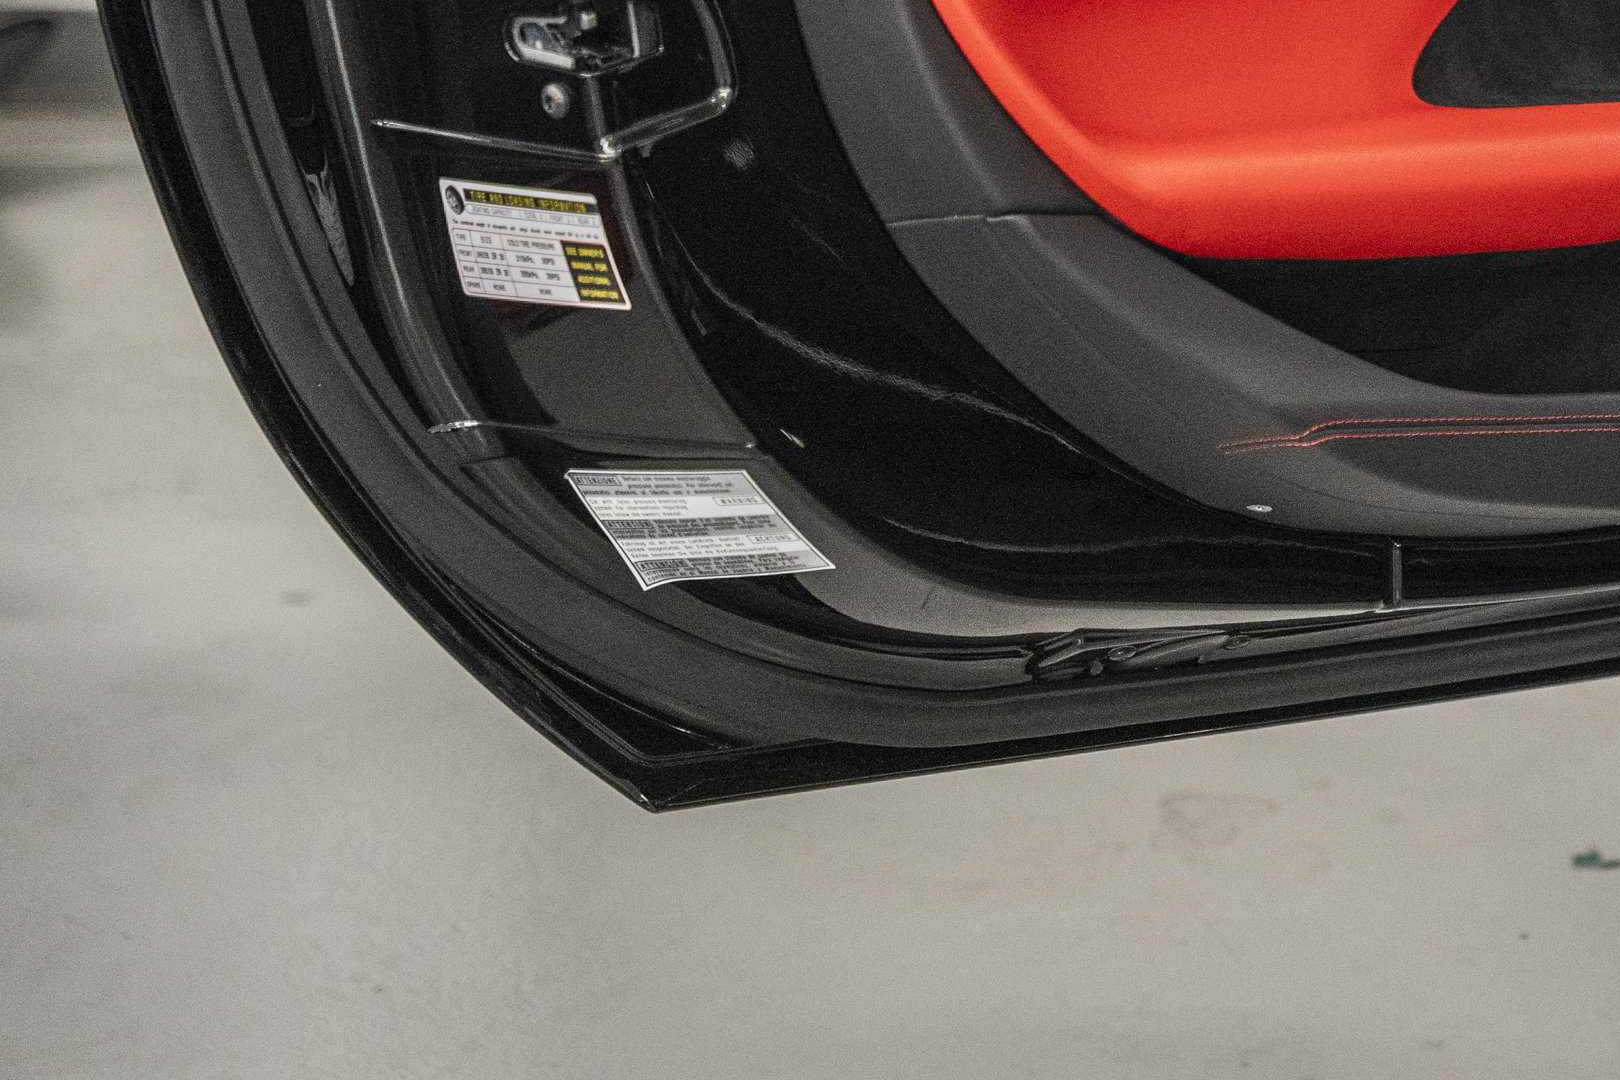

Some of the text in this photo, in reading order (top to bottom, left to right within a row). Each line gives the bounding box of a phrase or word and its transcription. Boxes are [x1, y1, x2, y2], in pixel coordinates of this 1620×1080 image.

[469, 190, 587, 214] TIRE AND LOADING INFORMATION
[575, 476, 619, 485] ATTENZIONE
[719, 496, 759, 505] WARNING
